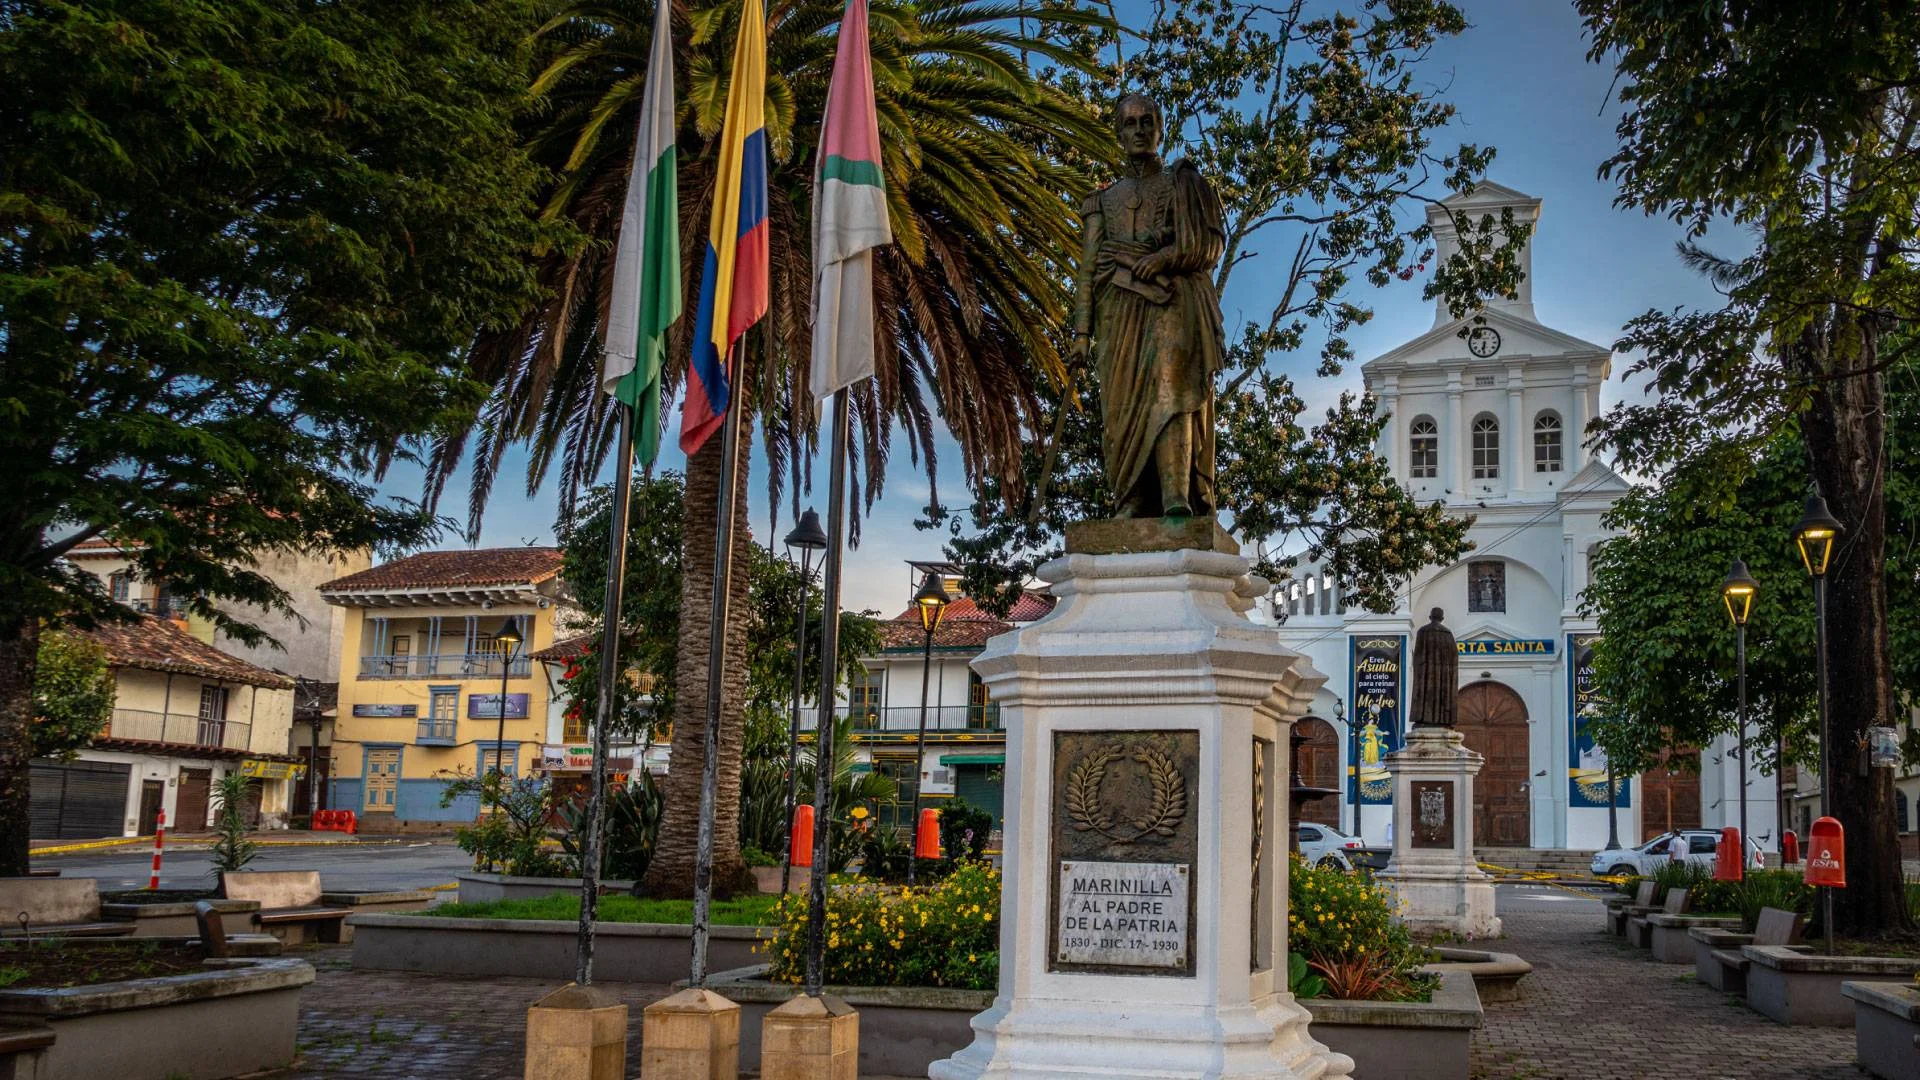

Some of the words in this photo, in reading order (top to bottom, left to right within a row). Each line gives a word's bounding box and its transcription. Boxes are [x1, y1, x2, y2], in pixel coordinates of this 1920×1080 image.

[1457, 641, 1487, 653] RTA
[1494, 641, 1546, 653] SANTA
[1357, 659, 1398, 673] Asunta
[1369, 656, 1385, 664] Eres
[1576, 694, 1588, 702] 70
[1073, 878, 1173, 894] MARINILLA
[1082, 900, 1101, 913] AL
[1106, 901, 1163, 915] PADRE
[1066, 917, 1088, 930] DE
[1093, 918, 1113, 931] LA
[1118, 919, 1178, 933] PATRIA
[1065, 937, 1090, 948] 1830
[1100, 939, 1126, 949] DIC.
[1130, 940, 1142, 949] 17
[1153, 940, 1179, 951] 1930
